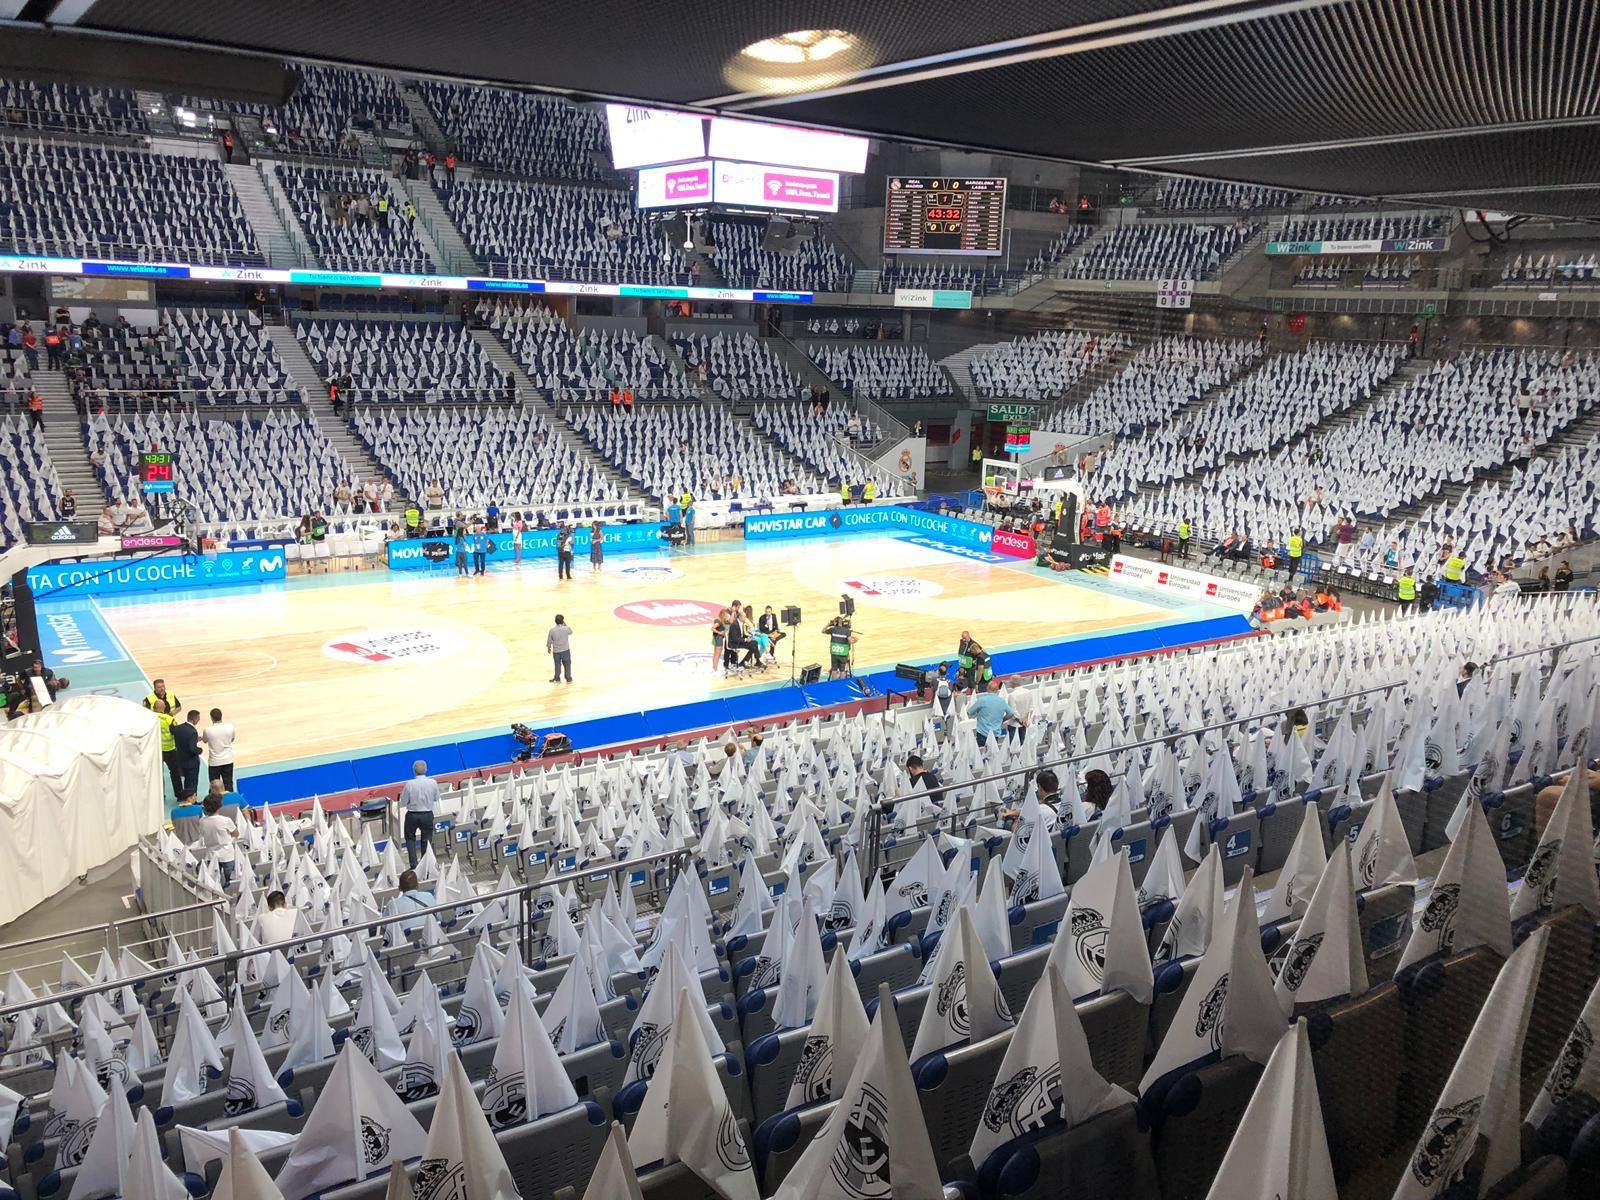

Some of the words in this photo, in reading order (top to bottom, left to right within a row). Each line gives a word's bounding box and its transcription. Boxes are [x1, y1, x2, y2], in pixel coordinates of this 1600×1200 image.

[952, 181, 960, 189] 0
[928, 209, 960, 219] 43:32
[1277, 244, 1311, 252] WiZink
[1394, 240, 1433, 250] WiZink
[1162, 281, 1169, 290] 2
[1181, 281, 1188, 290] 0
[1161, 297, 1167, 306] 0
[990, 404, 1036, 415] SALIDA
[145, 454, 171, 464] 43:31
[147, 465, 170, 481] 24
[747, 518, 803, 533] MOVISTAR
[805, 517, 826, 529] CAR
[845, 511, 889, 526] CONECTA
[891, 511, 908, 524] CON
[910, 514, 920, 526] TU
[921, 517, 949, 534] COCHE
[123, 537, 164, 547] endesa
[500, 538, 549, 551] COECTA
[993, 535, 1029, 550] endesa
[1124, 563, 1153, 575] Universidad
[57, 570, 100, 588] CON
[101, 567, 130, 584] TU
[134, 563, 196, 581] COCHE
[1123, 570, 1143, 580] Europea
[1170, 573, 1201, 587] Universidad
[1168, 580, 1191, 592] Europea
[1217, 591, 1241, 603] Europea
[1219, 585, 1253, 599] Universidad
[1226, 835, 1237, 850] 4
[529, 853, 537, 861] G
[558, 859, 567, 868] H
